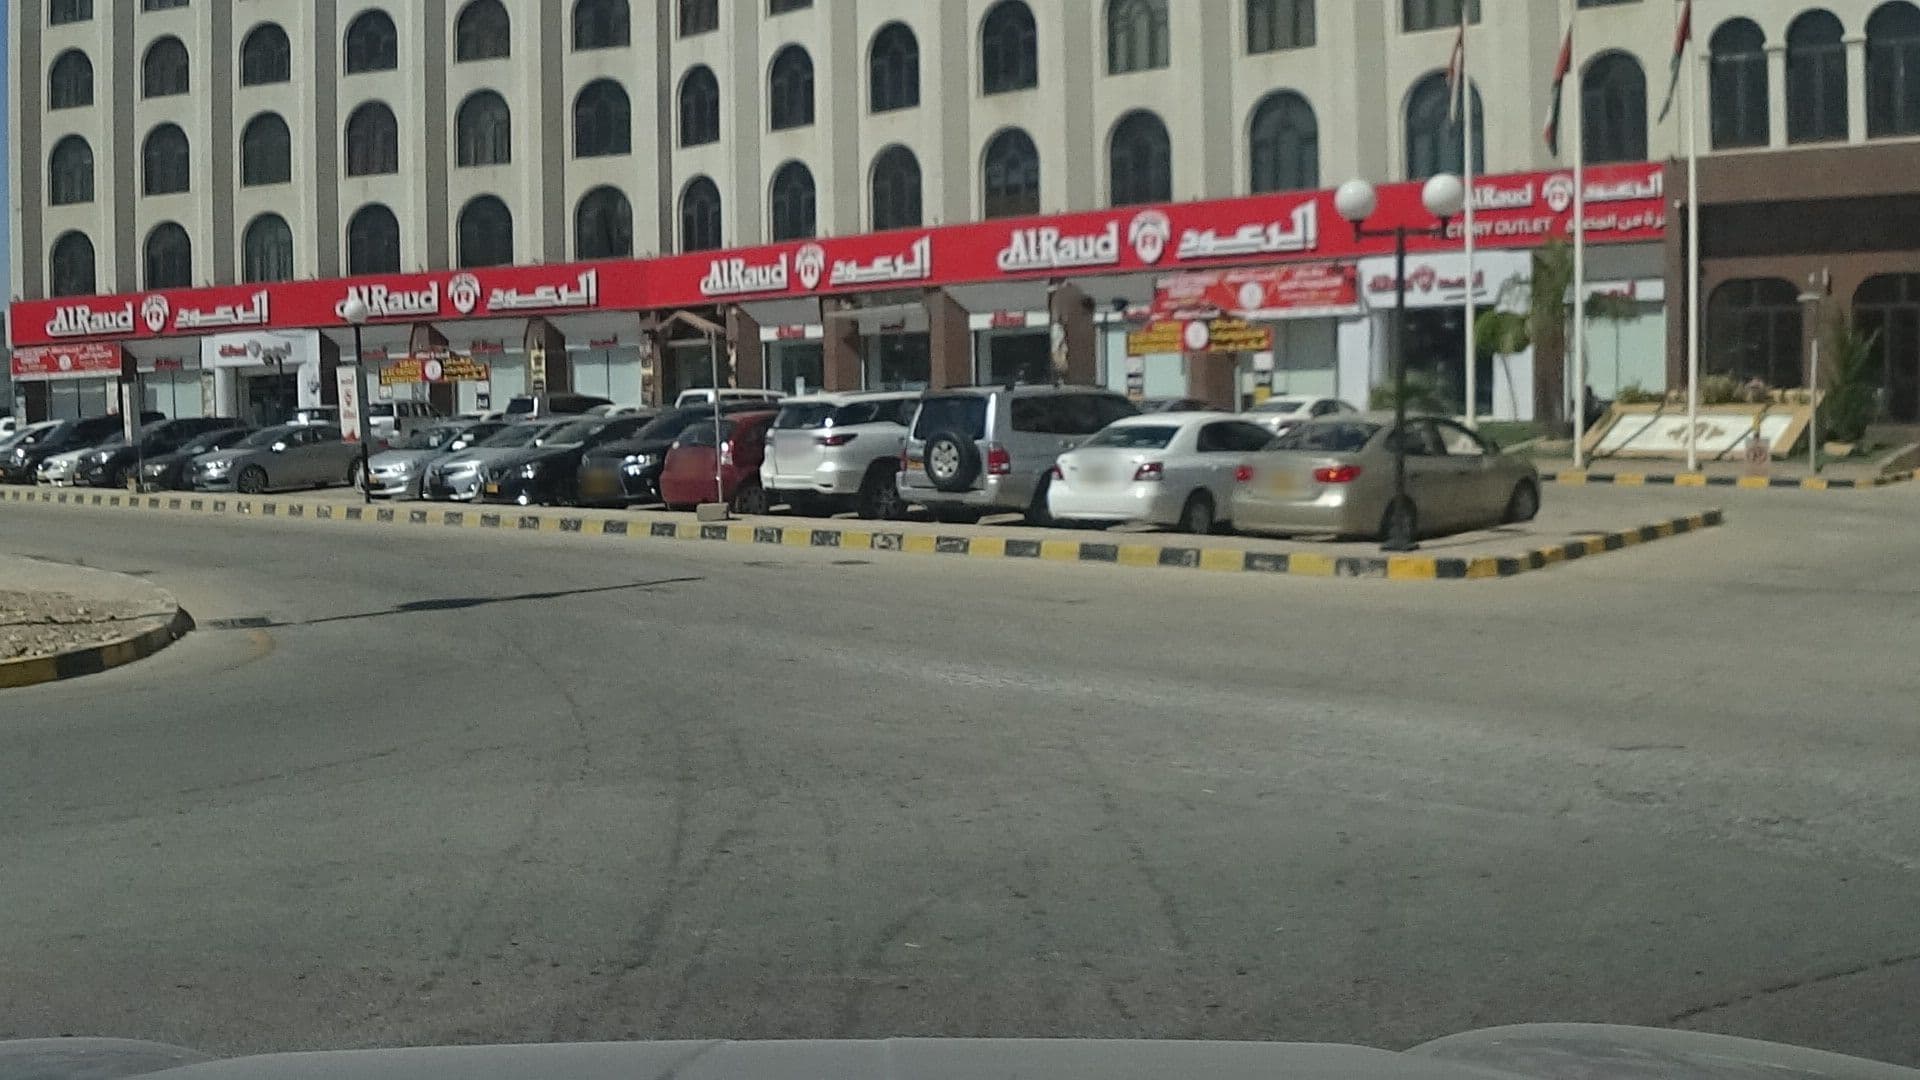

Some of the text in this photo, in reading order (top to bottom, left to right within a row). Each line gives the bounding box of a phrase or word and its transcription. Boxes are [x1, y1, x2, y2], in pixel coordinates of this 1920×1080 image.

[1494, 216, 1552, 235] OUTLET
[997, 219, 1120, 272] AlRaud
[700, 252, 788, 296] AlRaud
[335, 280, 438, 317] AlRaud
[45, 301, 134, 337] AlRaud
